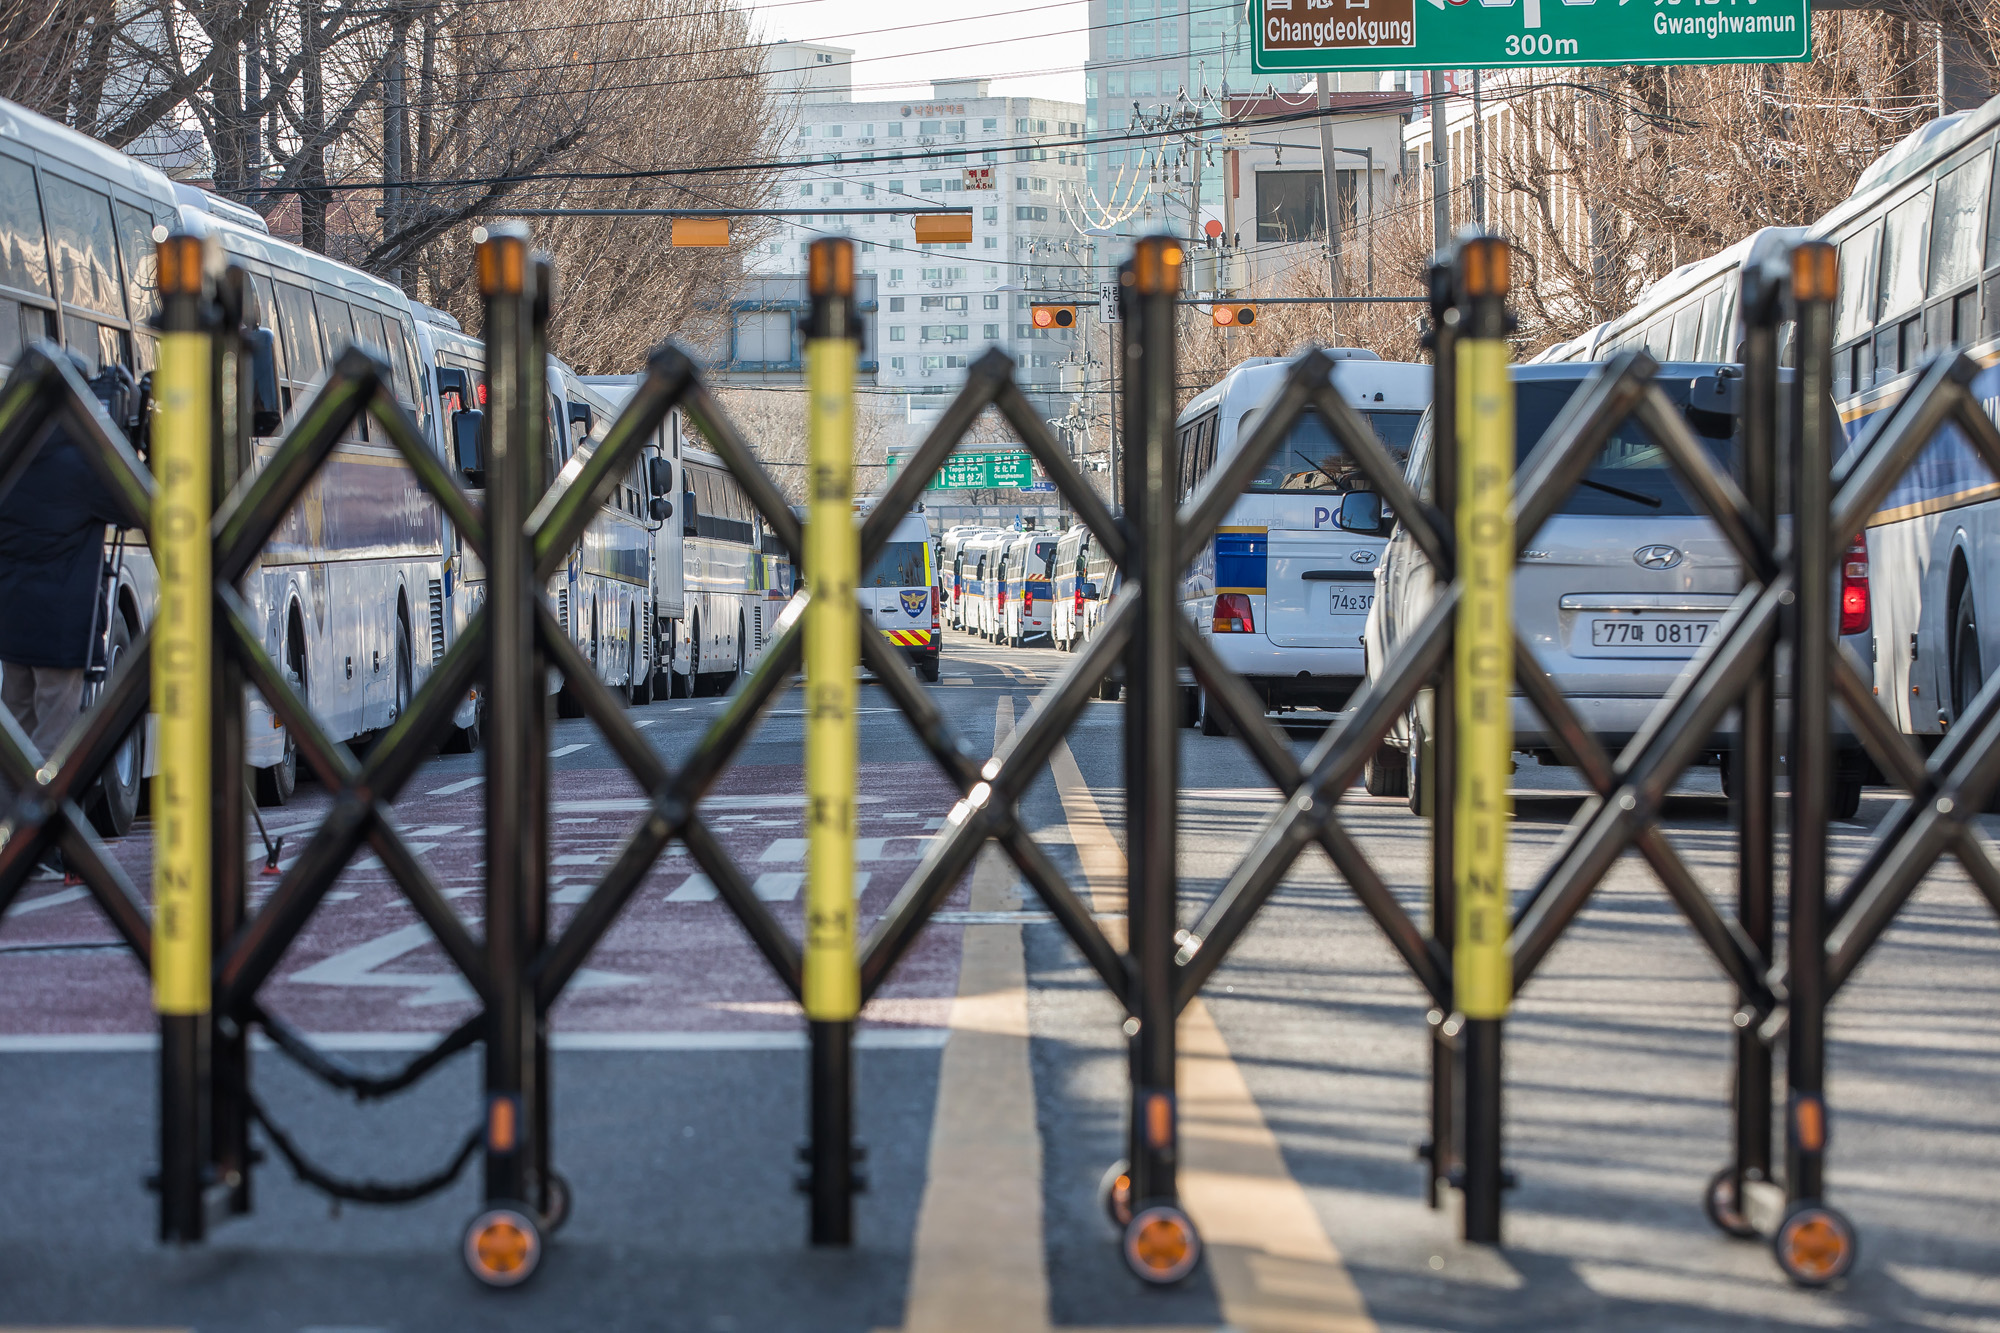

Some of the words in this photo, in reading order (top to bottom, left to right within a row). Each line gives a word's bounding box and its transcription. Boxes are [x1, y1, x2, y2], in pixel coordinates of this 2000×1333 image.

[1266, 15, 1411, 47] Changdeokgung
[1653, 11, 1796, 39] Gwanghwamun
[1505, 34, 1578, 56] 300m
[913, 104, 965, 117] 낙원아파트
[948, 472, 983, 482] 낙원상가
[1236, 518, 1284, 527] HYUNDAI
[158, 456, 198, 720] POLICE
[1469, 464, 1508, 725] POLICE
[1332, 595, 1375, 610] 74오30
[1655, 623, 1709, 643] 0817
[162, 767, 193, 942] LINE
[1469, 776, 1501, 945] LINE
